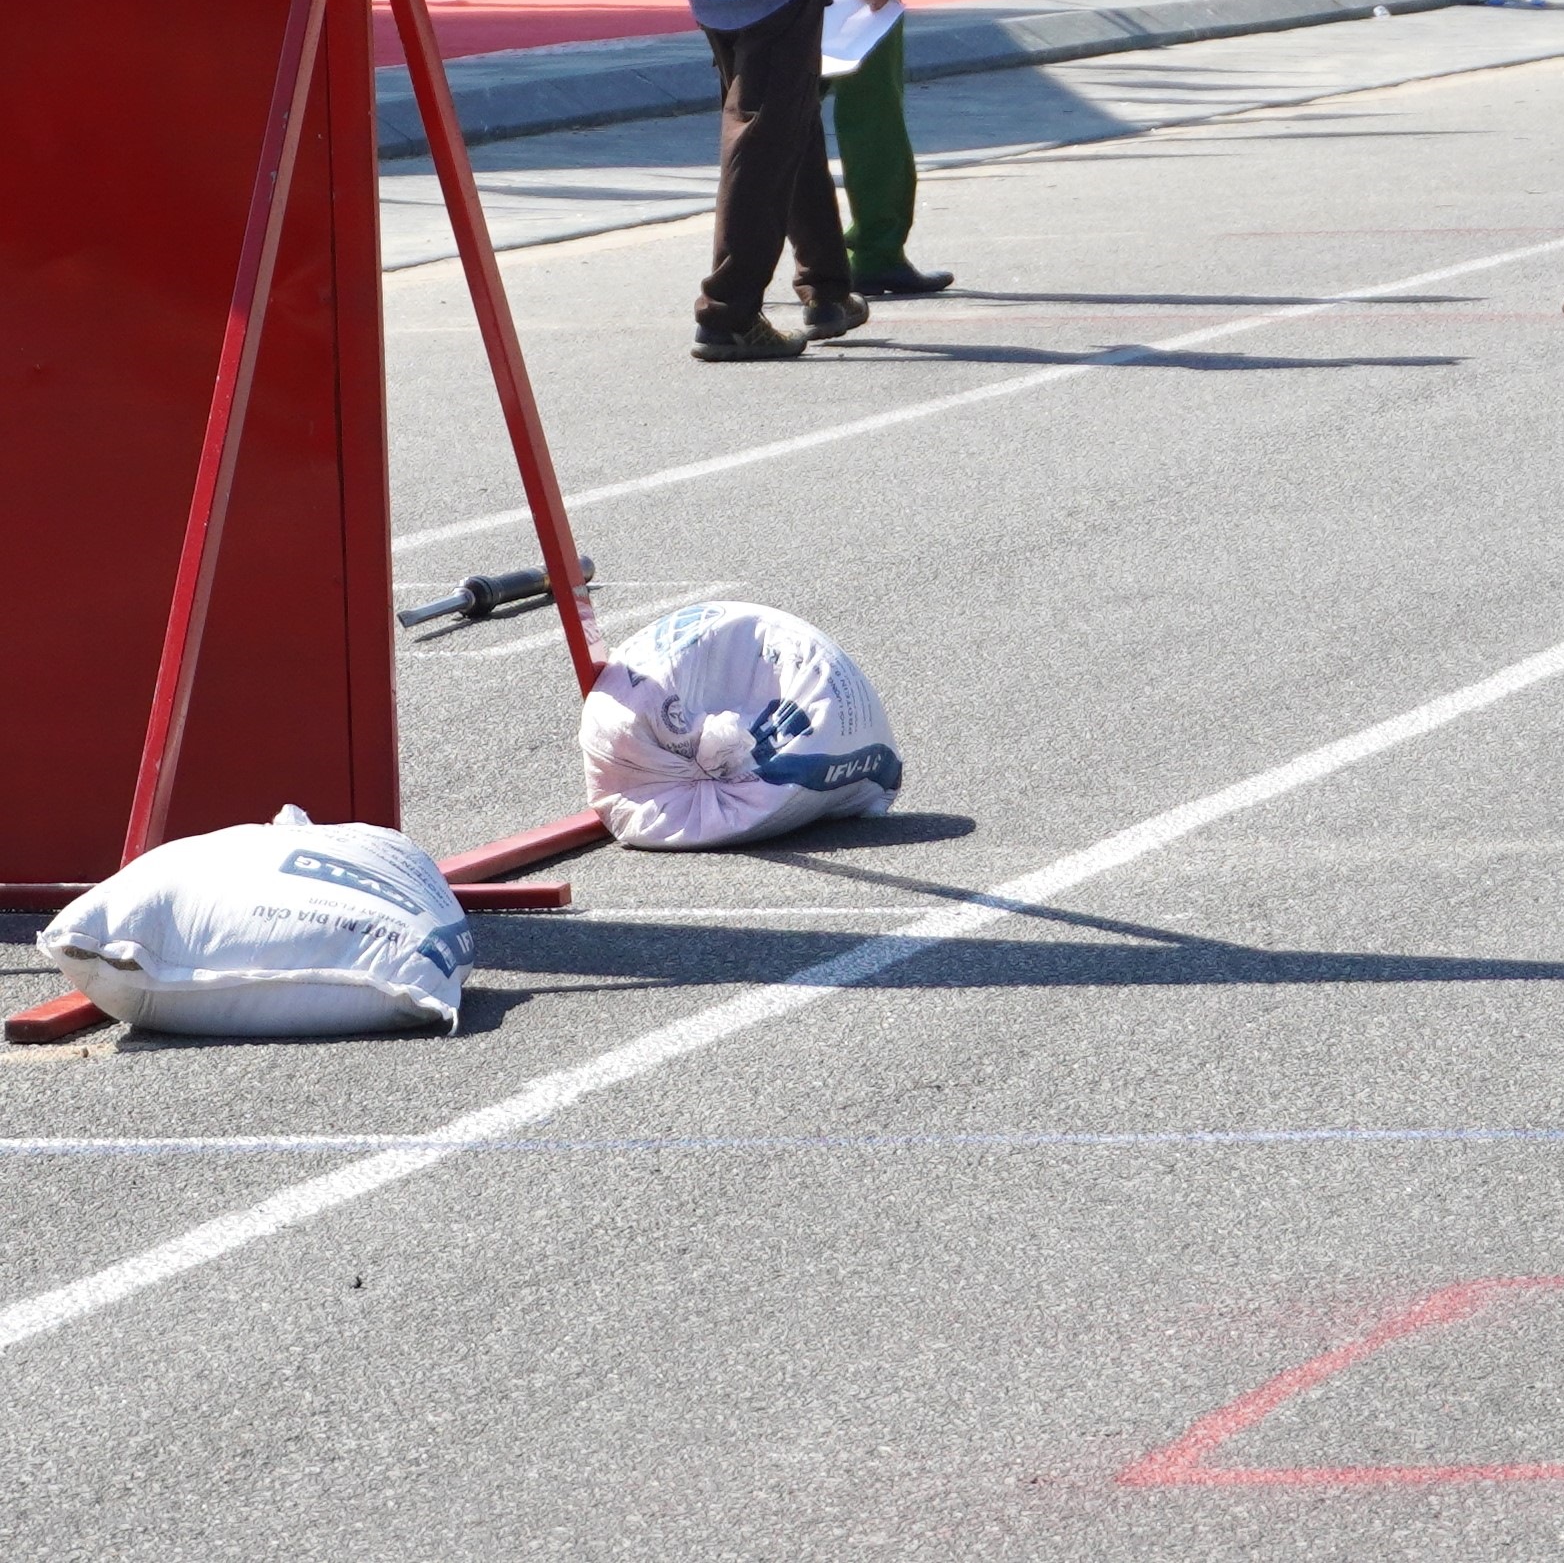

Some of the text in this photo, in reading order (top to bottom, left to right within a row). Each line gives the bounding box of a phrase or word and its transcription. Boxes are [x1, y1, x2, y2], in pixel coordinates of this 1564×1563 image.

[308, 897, 356, 913] FLOUR
[250, 904, 291, 924] CẦU
[297, 909, 330, 926] ĐỊA
